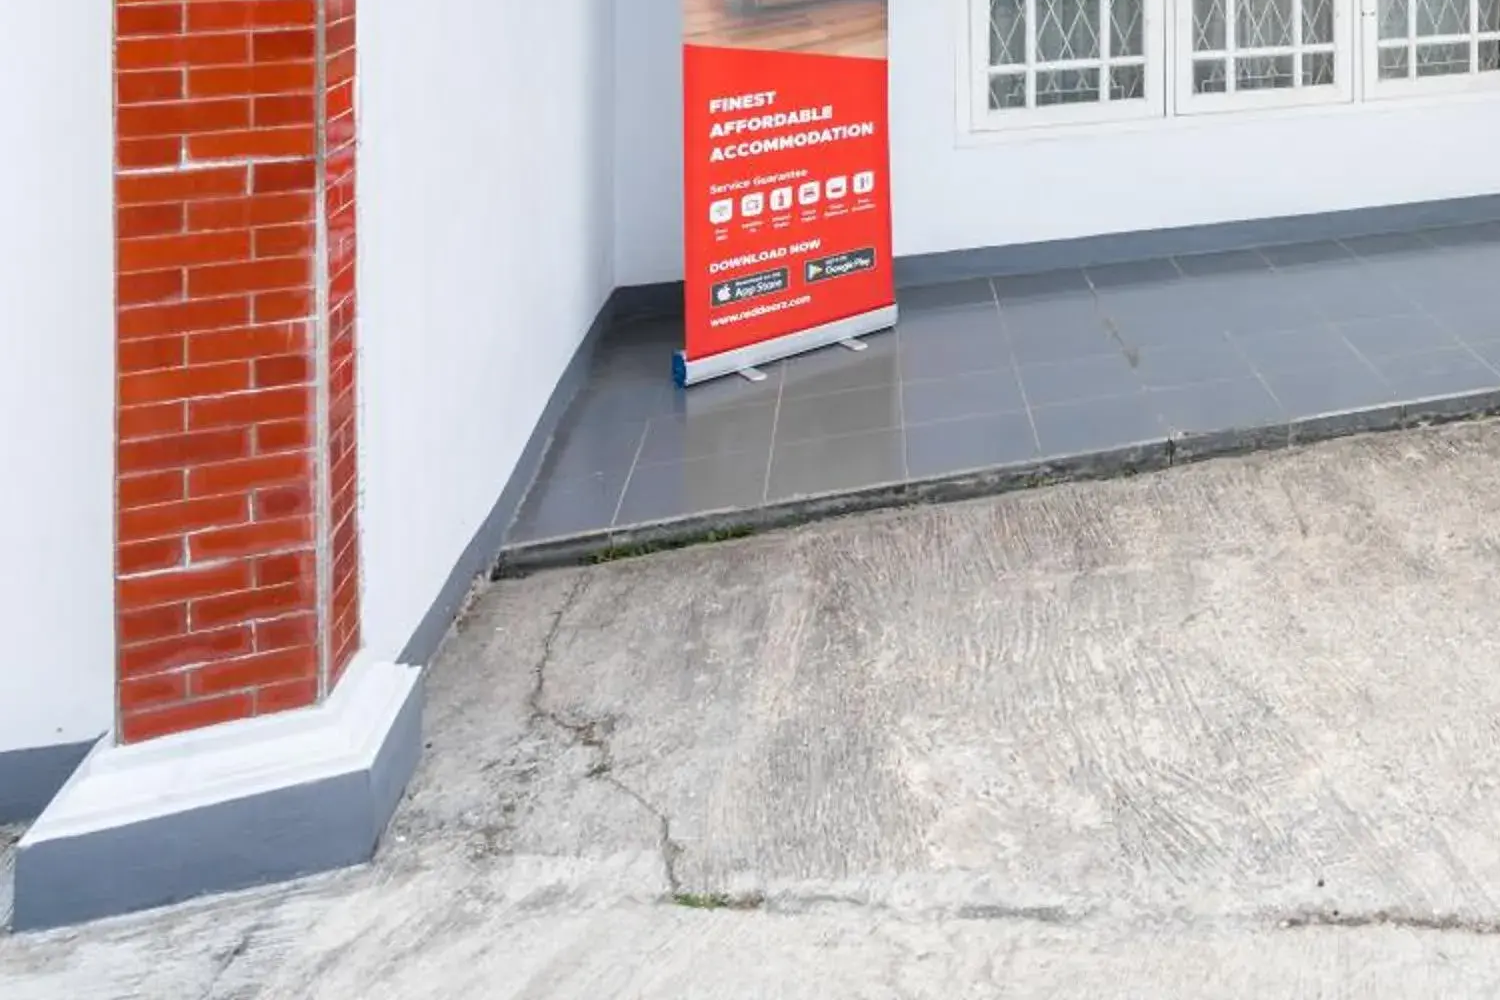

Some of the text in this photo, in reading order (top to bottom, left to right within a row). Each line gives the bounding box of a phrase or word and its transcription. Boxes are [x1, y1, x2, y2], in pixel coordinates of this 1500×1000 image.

[709, 91, 777, 114] FINEST
[709, 105, 833, 138] AFFORDABLE
[709, 122, 875, 162] ACCOMMODATION
[709, 169, 808, 195] Service Guarantee
[709, 238, 822, 274] DOWNLOAD NOW
[825, 262, 854, 276] Google
[735, 278, 783, 299] App Store
[710, 294, 812, 327] www.reddoorz.com
